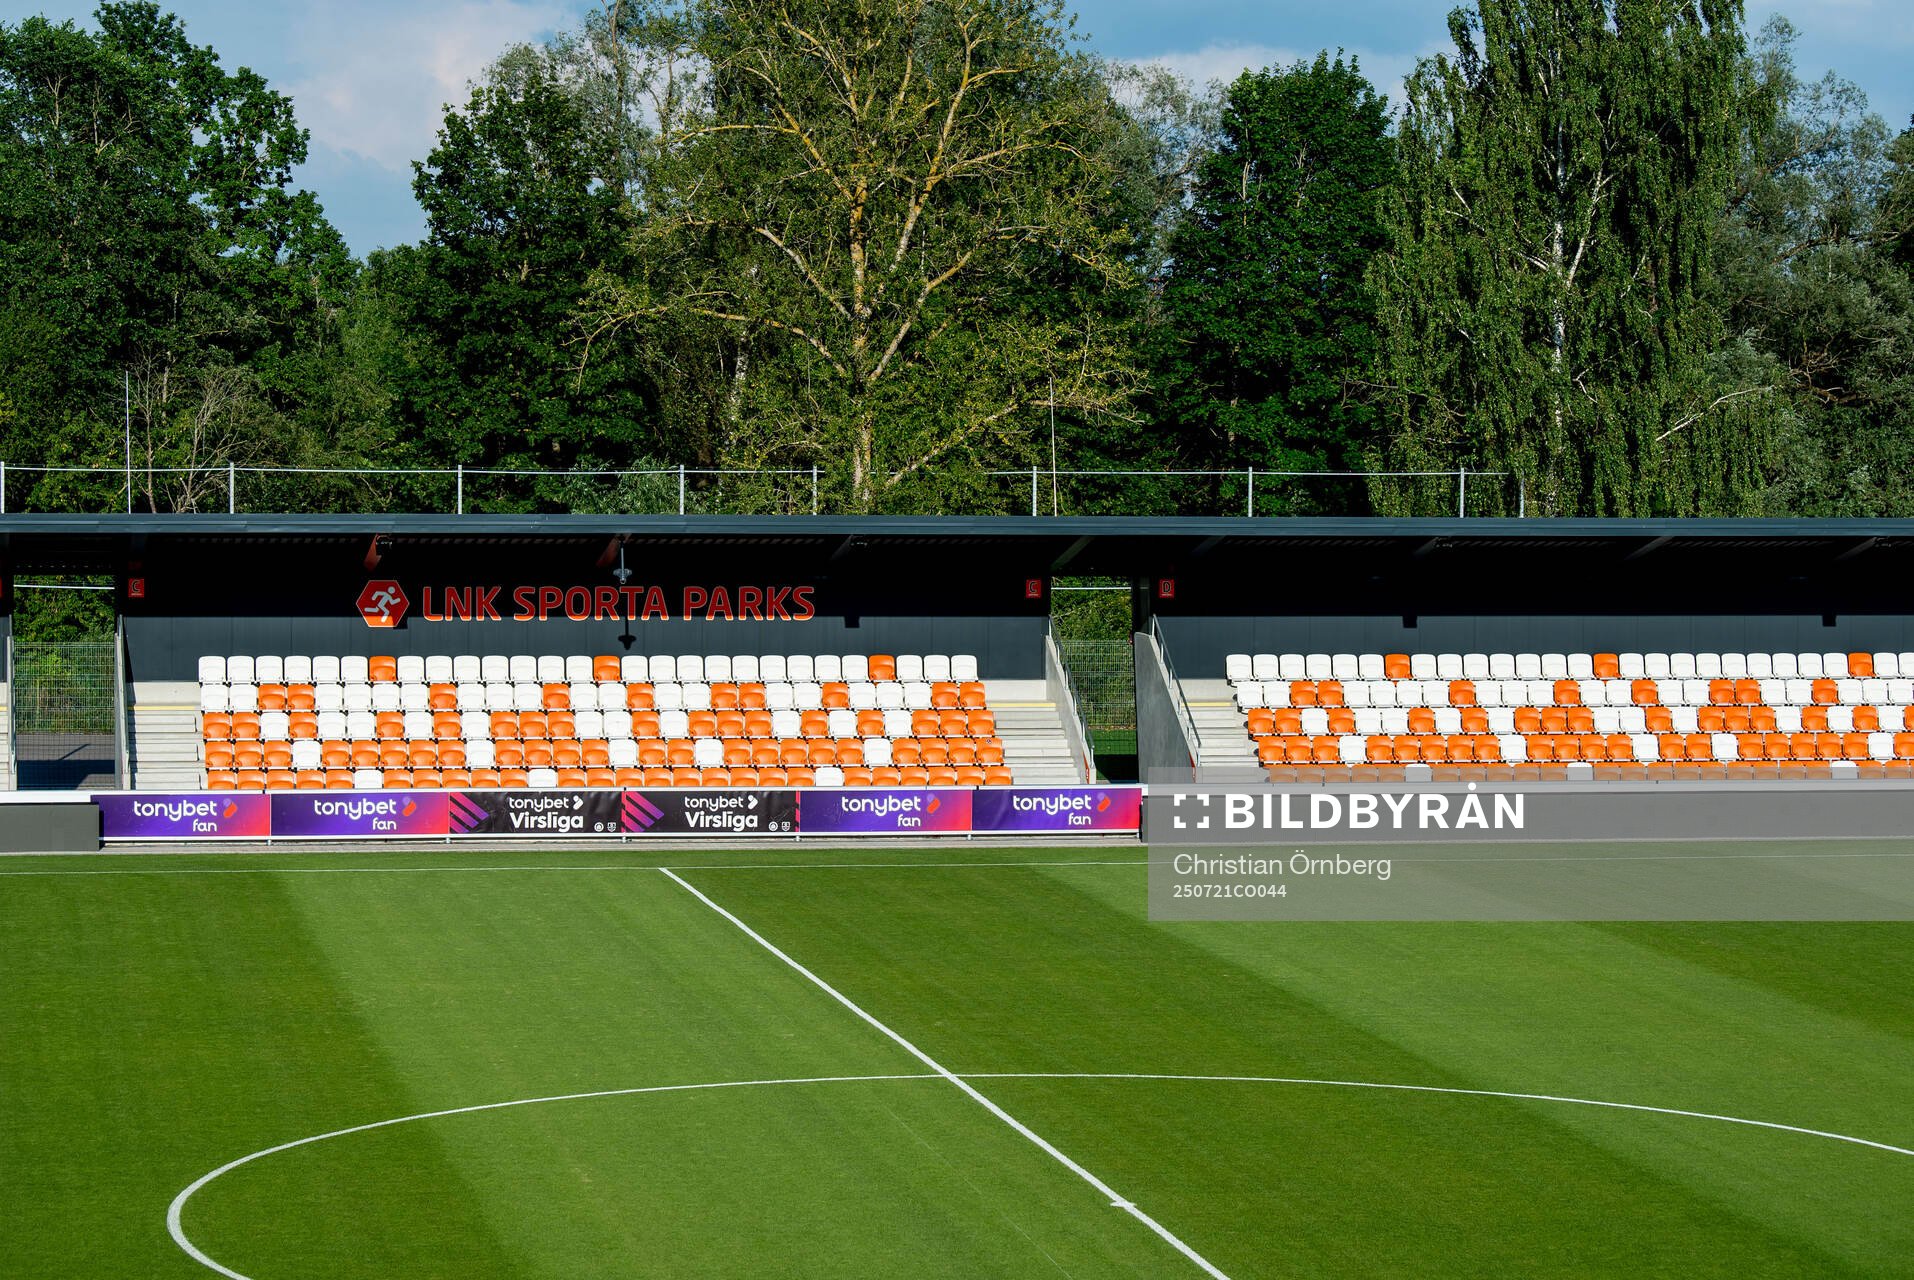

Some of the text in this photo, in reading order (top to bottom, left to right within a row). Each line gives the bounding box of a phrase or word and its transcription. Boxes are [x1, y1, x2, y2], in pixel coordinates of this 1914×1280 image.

[422, 585, 815, 621] LNK SPORTA PARKS
[132, 799, 218, 822] tonybet
[313, 797, 397, 821] tonybet
[508, 796, 570, 813] tonybet
[684, 795, 744, 812] tonybet
[841, 796, 921, 817] tonybet
[1012, 795, 1092, 816] tonybet
[191, 818, 218, 833] fan
[372, 816, 397, 831] fan
[509, 812, 584, 832] Virslīga
[684, 811, 759, 832] Virslīga
[897, 812, 921, 827] fan
[1067, 812, 1092, 826] fan
